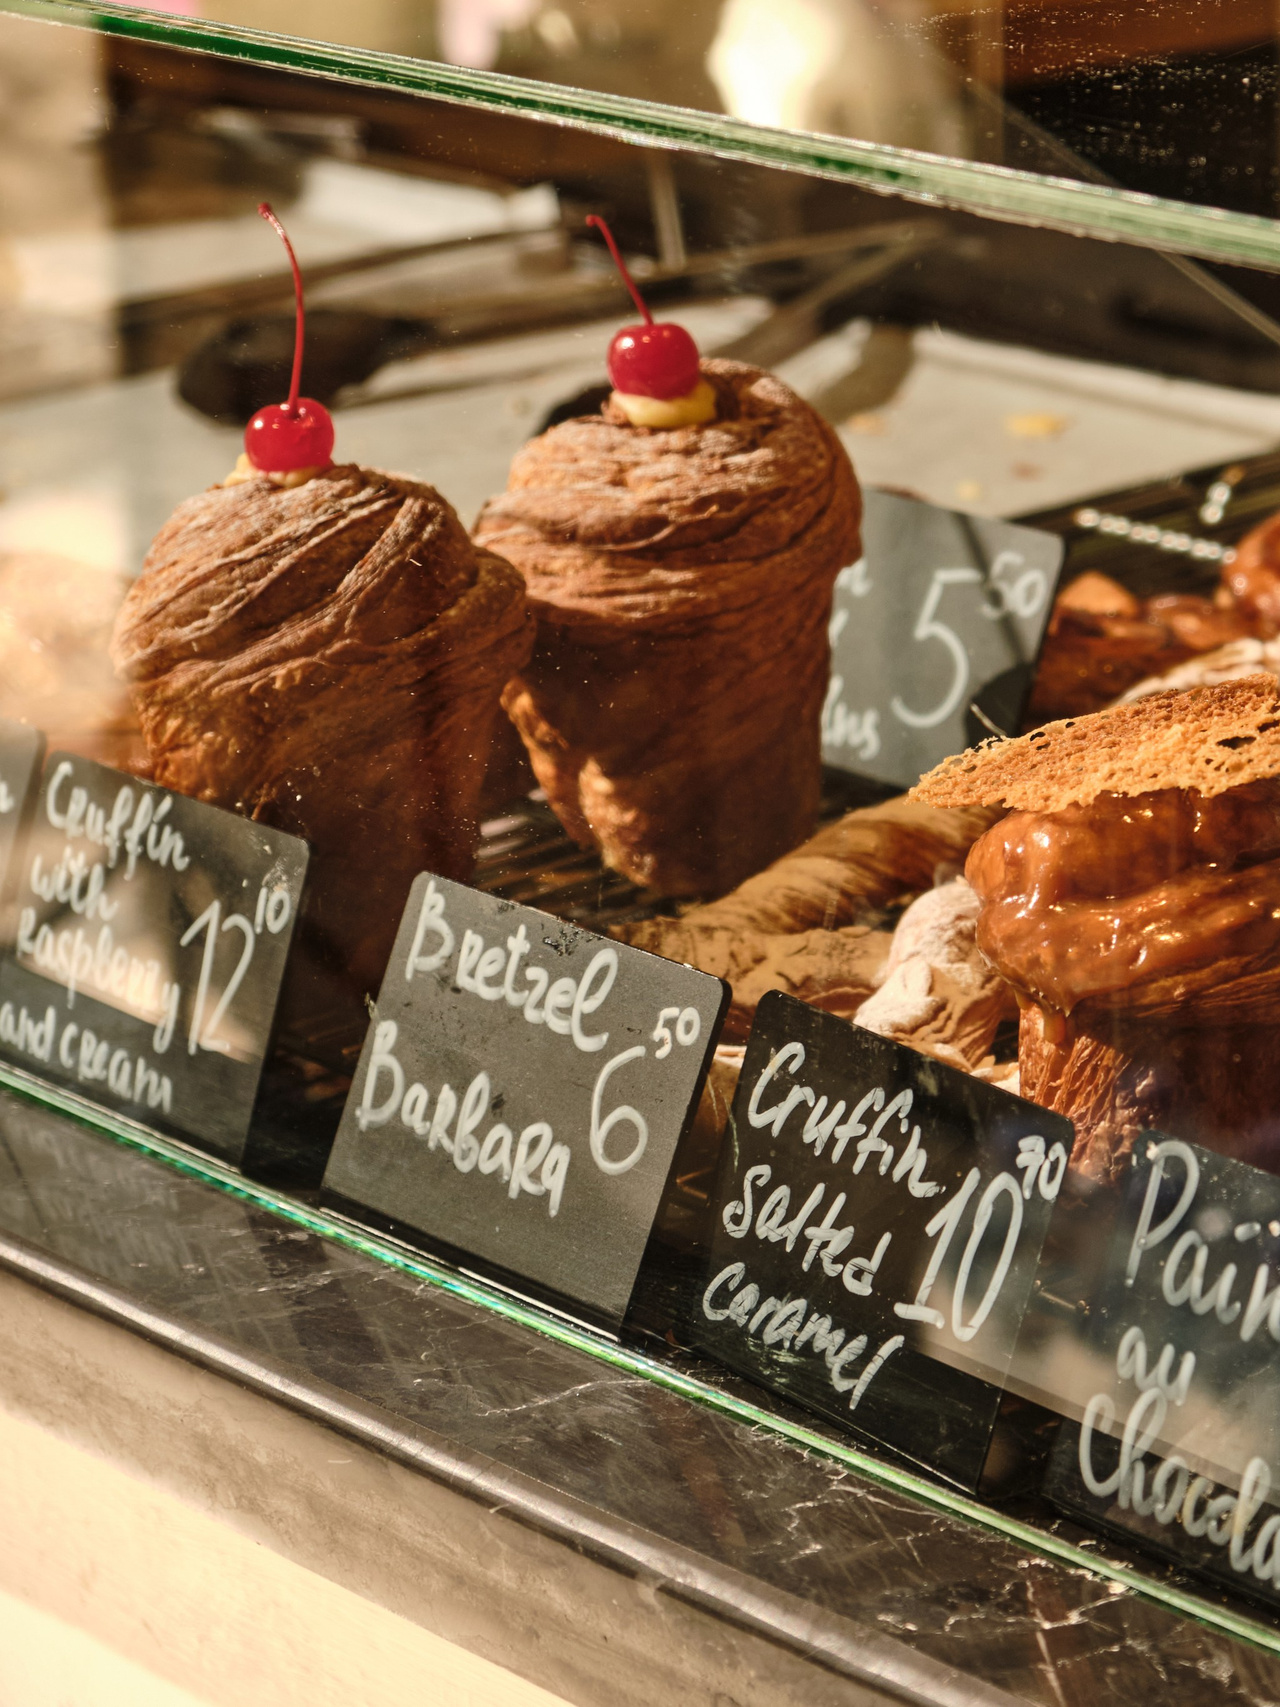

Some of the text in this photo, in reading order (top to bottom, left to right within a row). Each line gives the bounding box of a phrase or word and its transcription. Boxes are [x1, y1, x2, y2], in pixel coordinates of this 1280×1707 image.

[980, 551, 1047, 619] 50
[891, 567, 969, 729] 5
[30, 845, 118, 921] with
[255, 886, 291, 935] 10
[0, 1002, 56, 1062] and
[651, 1007, 701, 1059] 50
[589, 1045, 648, 1176] 6
[748, 1041, 946, 1198] Cruffin
[722, 1164, 892, 1296] Salted
[894, 1167, 1024, 1341] 10
[702, 1262, 905, 1410] Caramel
[1116, 1326, 1196, 1405] au
